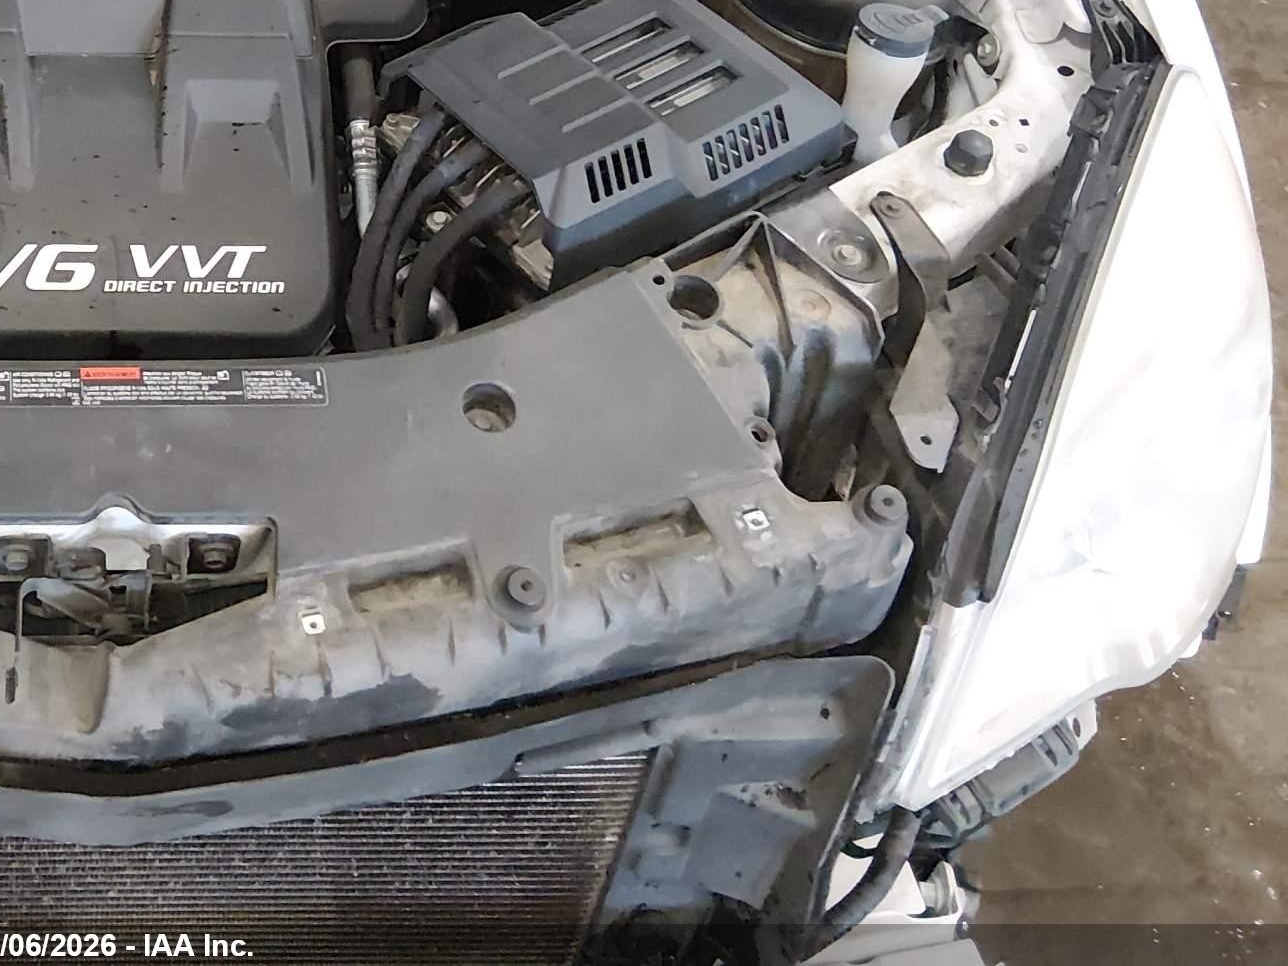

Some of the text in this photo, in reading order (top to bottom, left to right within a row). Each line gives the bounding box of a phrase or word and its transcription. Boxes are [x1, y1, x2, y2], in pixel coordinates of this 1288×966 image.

[129, 244, 267, 278] VVT
[104, 279, 285, 294] DIRECT INJECTION
